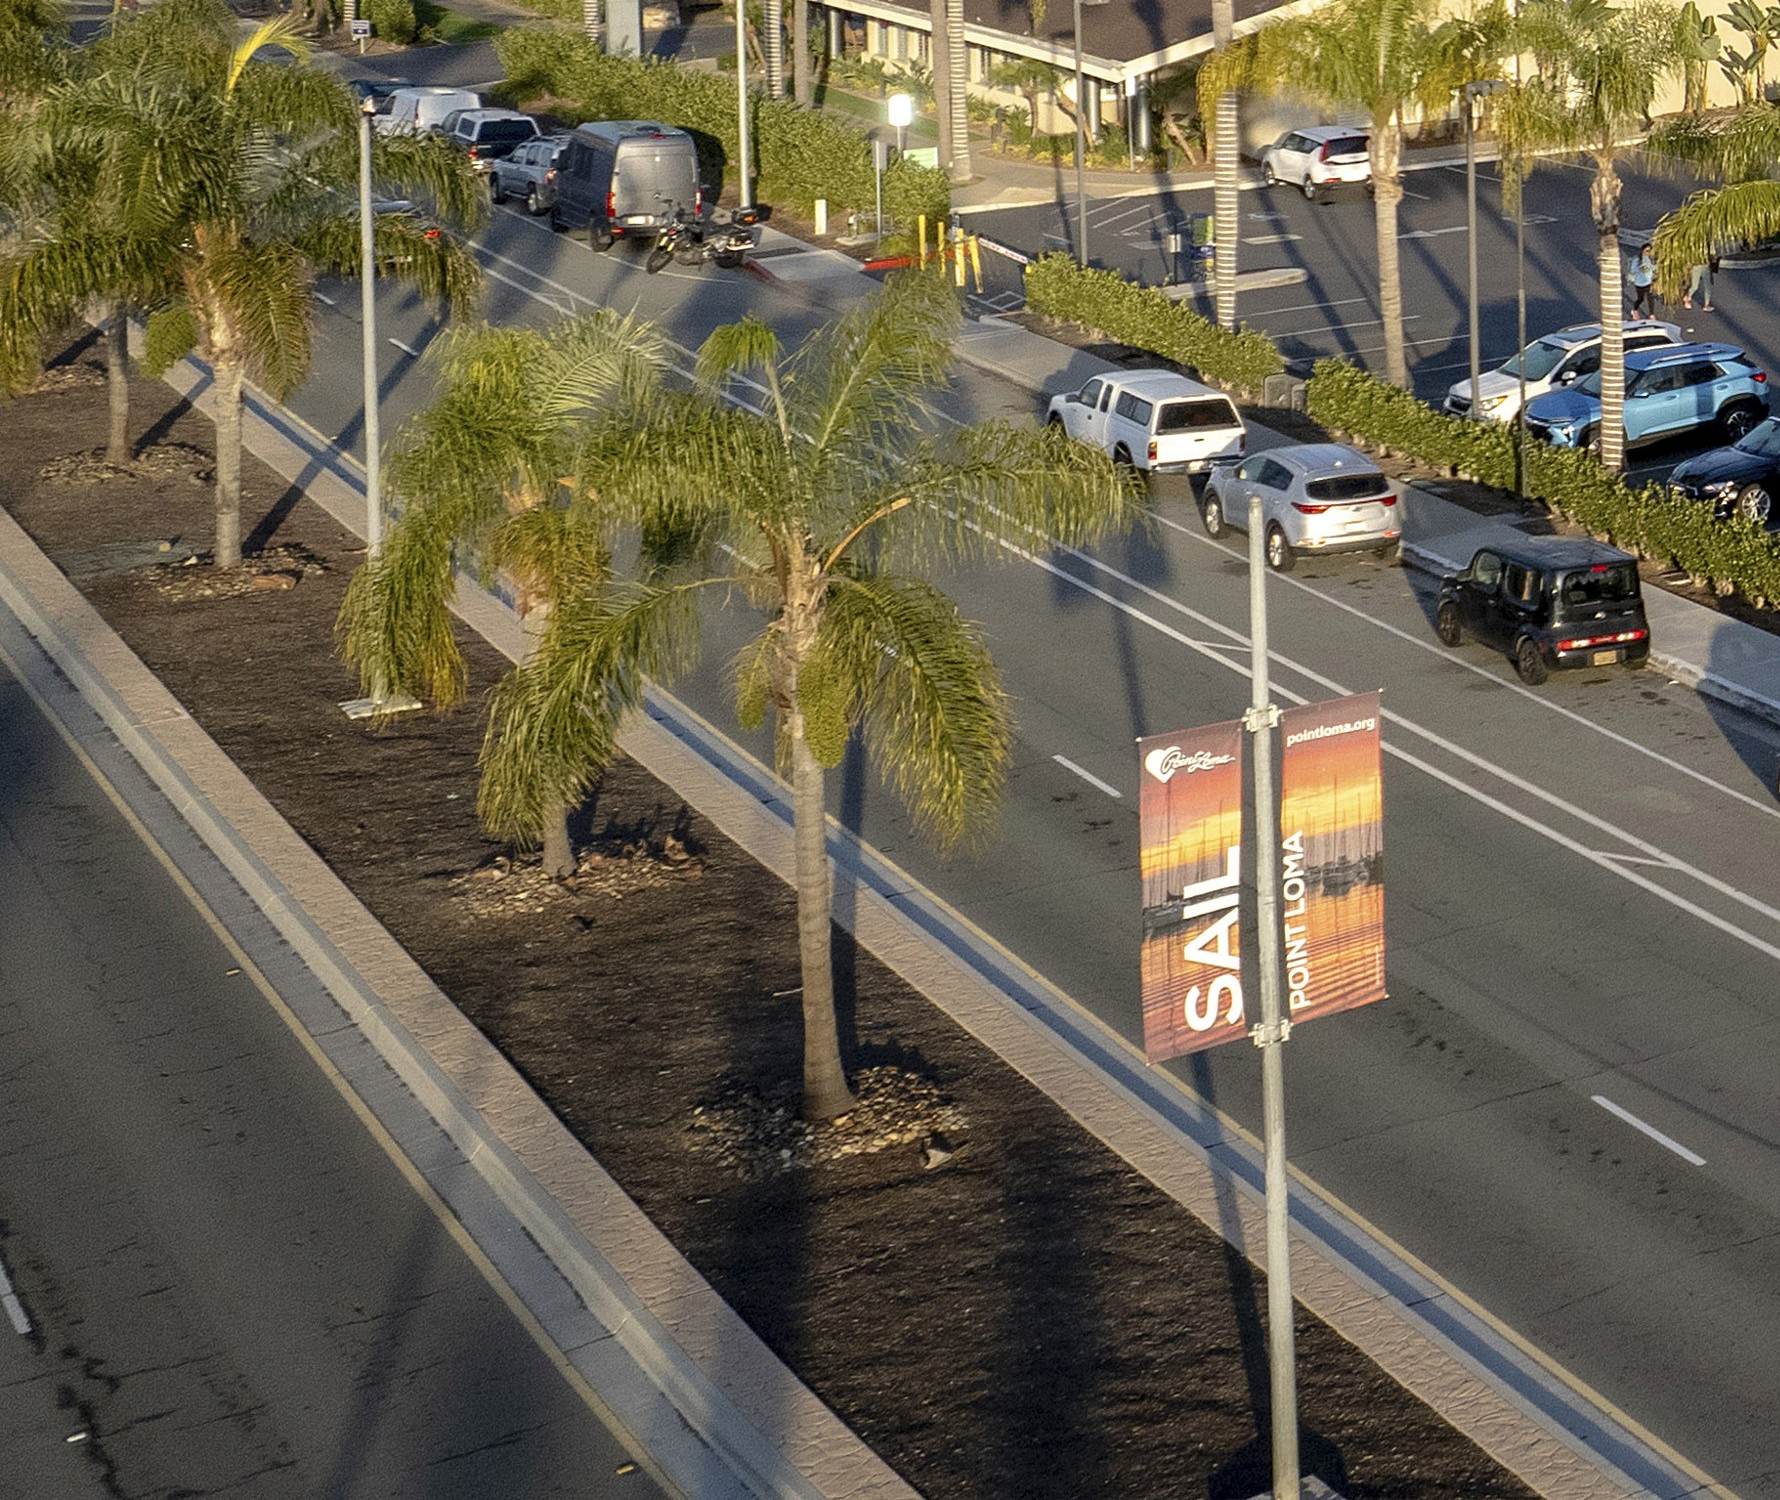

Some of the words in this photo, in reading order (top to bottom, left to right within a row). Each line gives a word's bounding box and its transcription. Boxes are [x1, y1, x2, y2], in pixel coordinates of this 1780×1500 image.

[1286, 717, 1376, 748] pointloma.org
[1283, 830, 1305, 917] LOMA
[1183, 845, 1244, 1031] SAIL
[1285, 922, 1312, 1011] POINT
